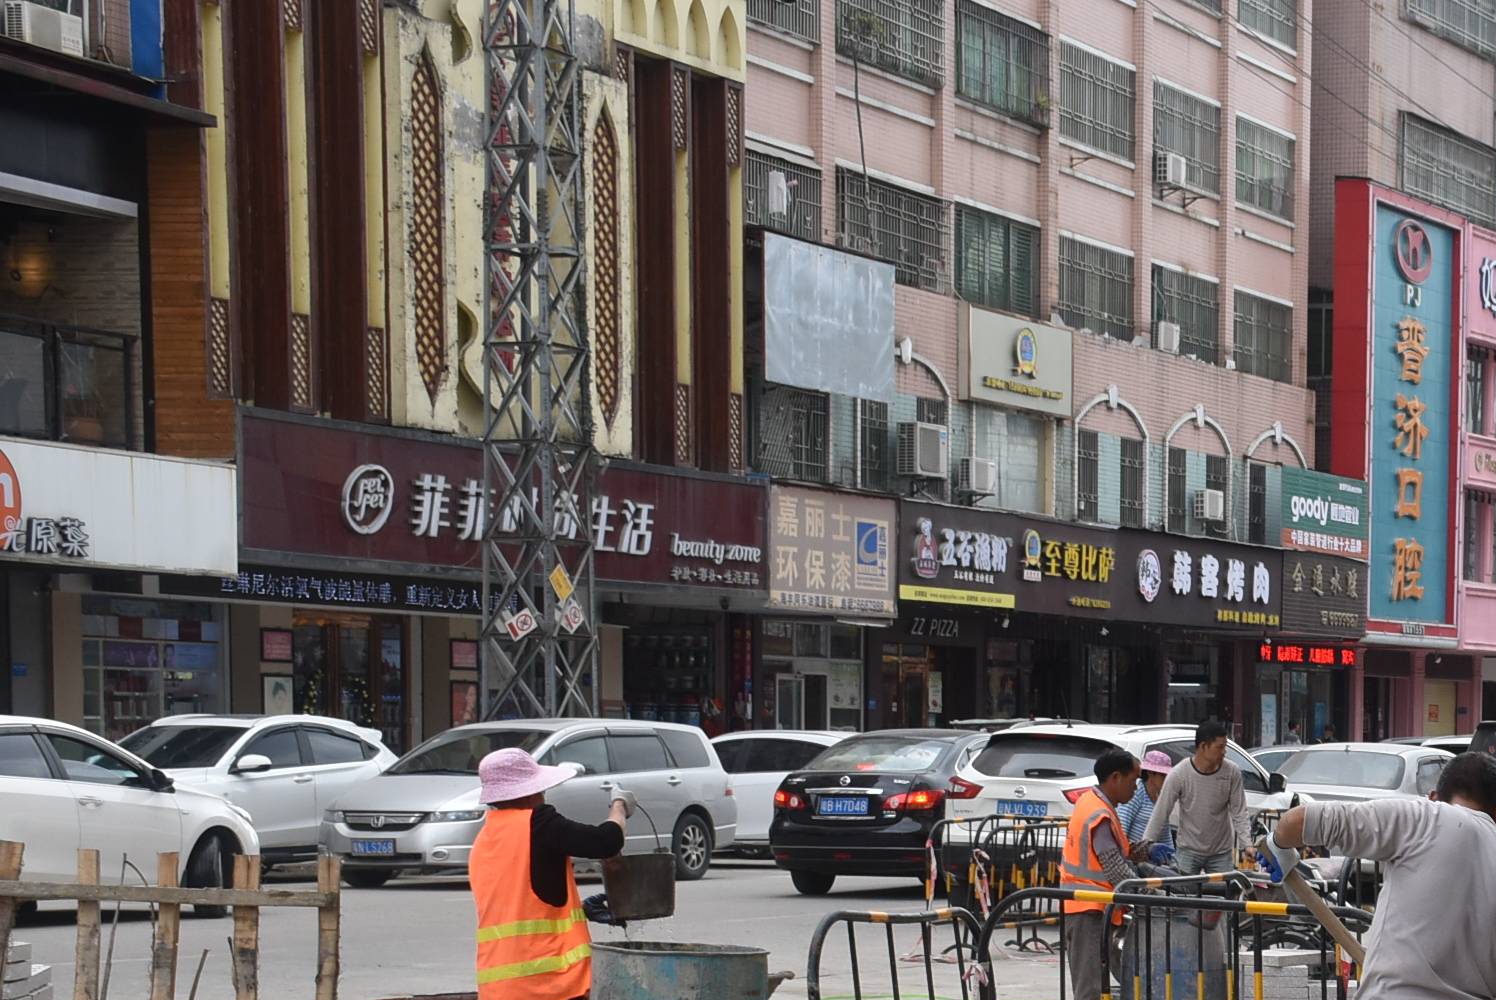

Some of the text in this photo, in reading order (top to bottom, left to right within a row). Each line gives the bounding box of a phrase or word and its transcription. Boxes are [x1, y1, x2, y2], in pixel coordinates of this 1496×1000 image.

[1405, 284, 1422, 307] PJ
[1391, 315, 1429, 602] 普济口腔
[777, 495, 852, 542] 嘉丽士
[1290, 495, 1330, 527] goody
[670, 532, 761, 565] beauty zone
[1044, 540, 1116, 583] 至尊比萨
[776, 545, 852, 592] 环保漆
[929, 619, 959, 637] PIZZA
